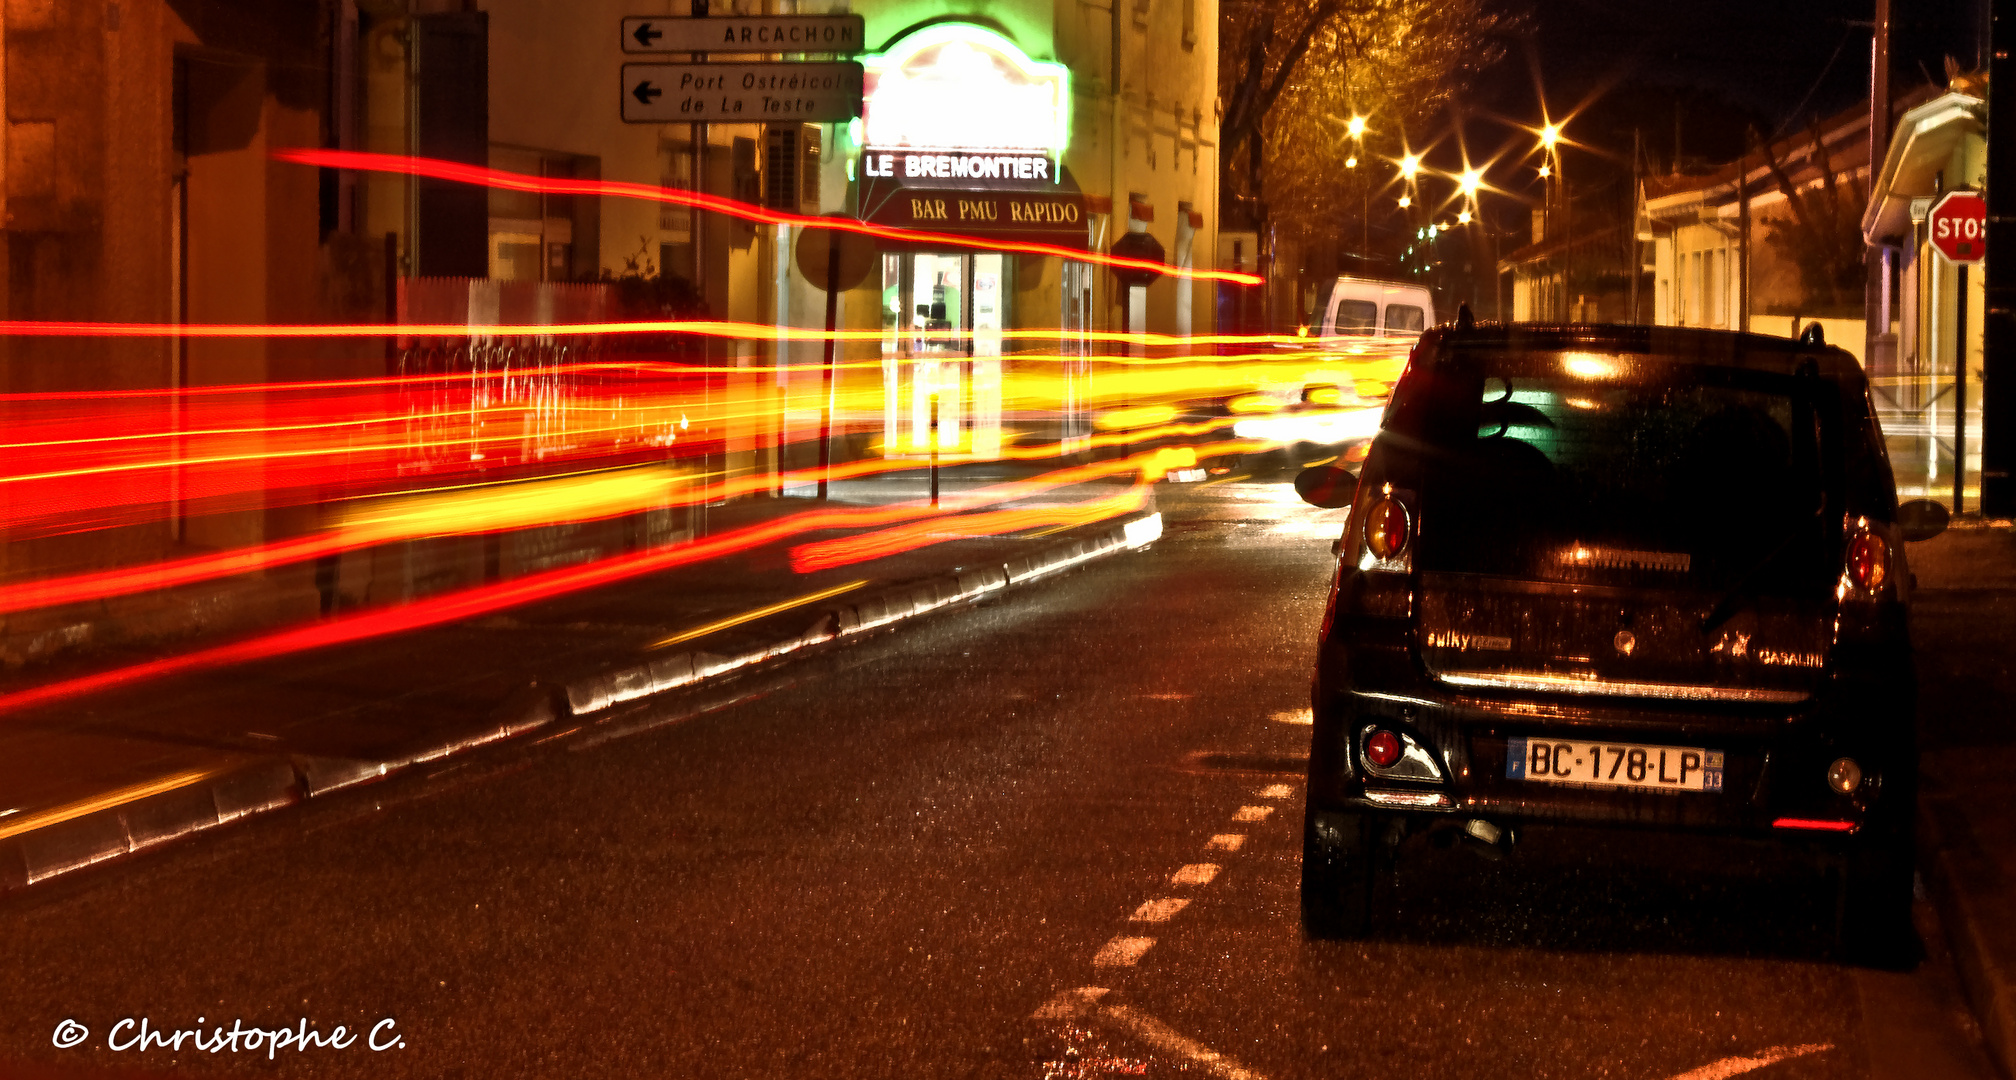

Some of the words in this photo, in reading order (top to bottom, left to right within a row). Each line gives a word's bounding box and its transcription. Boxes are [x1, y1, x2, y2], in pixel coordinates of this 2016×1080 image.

[724, 25, 853, 42] ARCACHON
[680, 73, 724, 90] Port
[681, 96, 704, 113] de
[721, 96, 743, 113] La
[763, 96, 815, 113] Teste
[866, 155, 893, 177] LE
[905, 155, 1048, 179] BREMONTIER
[912, 199, 948, 220] BAR
[959, 201, 998, 221] PMU
[1010, 201, 1079, 223] RAPIDO
[1512, 761, 1520, 772] F
[1704, 770, 1722, 788] 33
